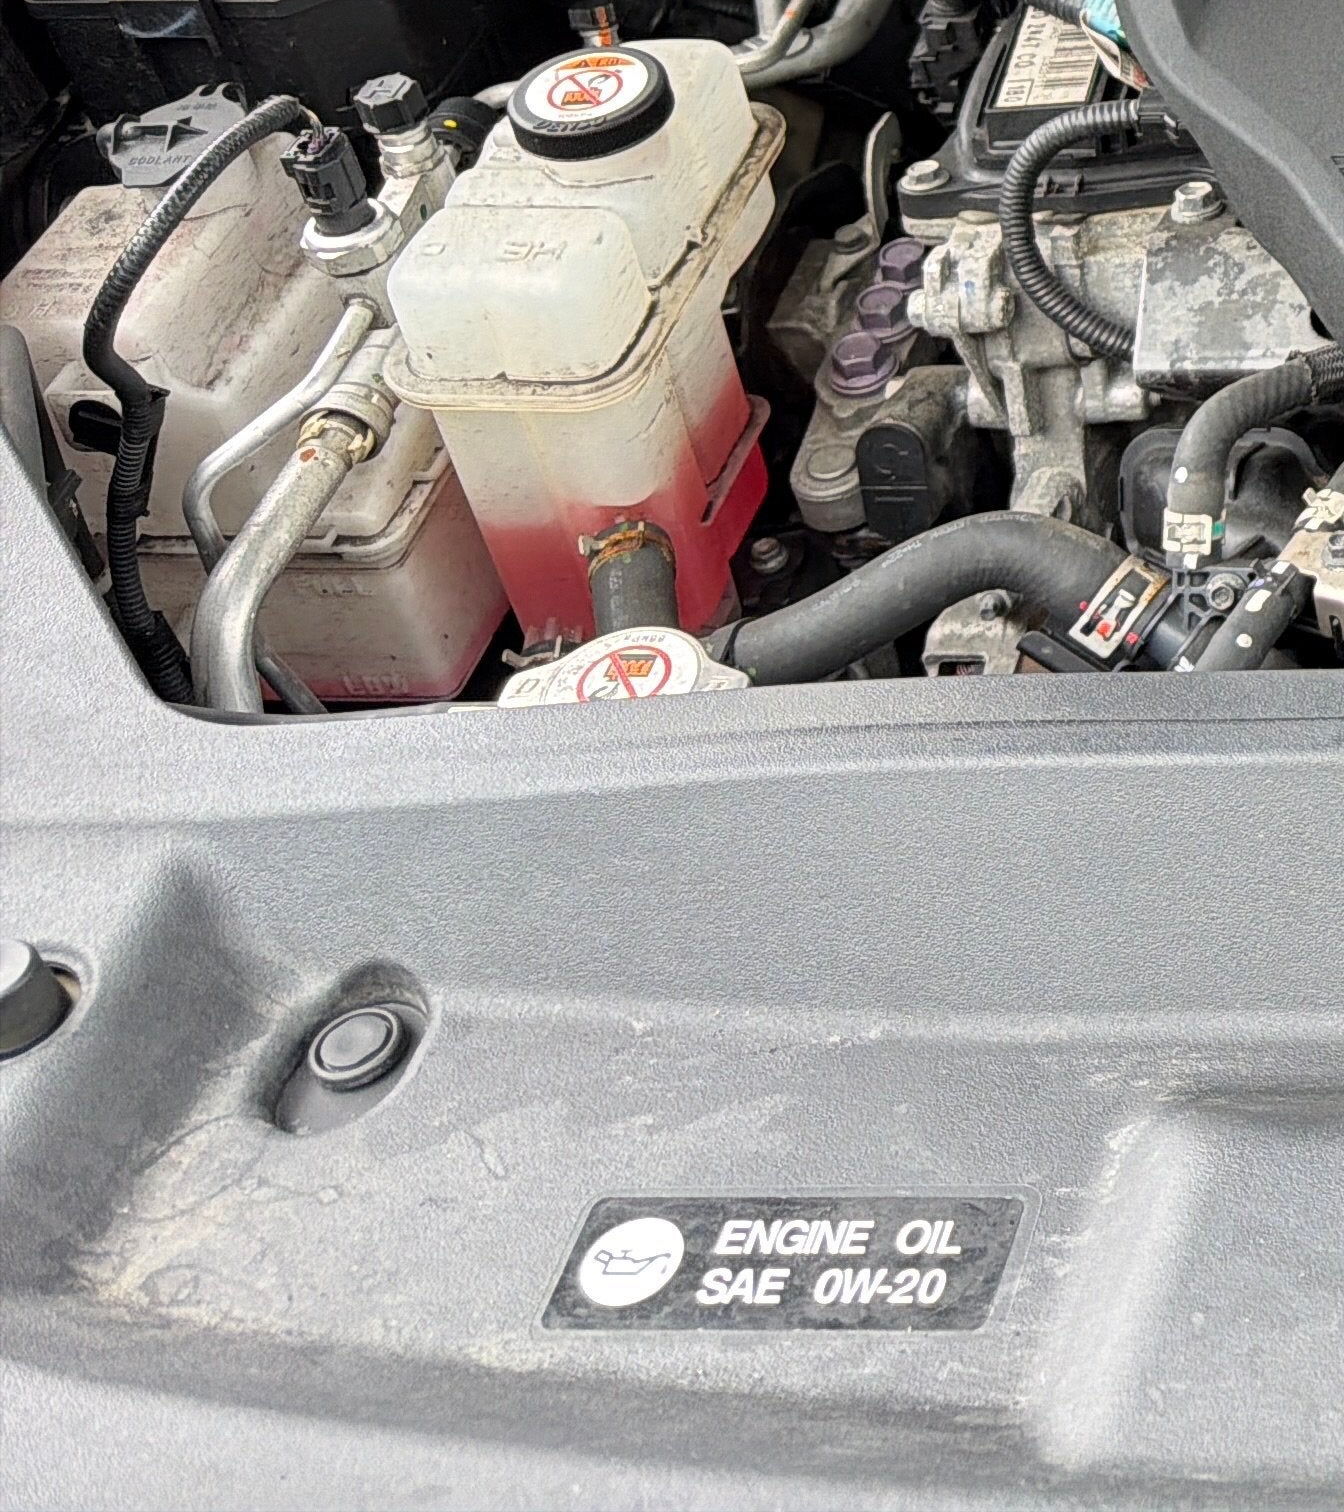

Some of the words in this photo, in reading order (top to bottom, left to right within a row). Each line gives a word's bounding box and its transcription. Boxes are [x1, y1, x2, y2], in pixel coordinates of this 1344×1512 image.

[714, 1219, 875, 1255] ENGINE
[895, 1219, 962, 1255] OIL
[696, 1267, 791, 1305] SAE
[812, 1267, 948, 1305] 0W-20
